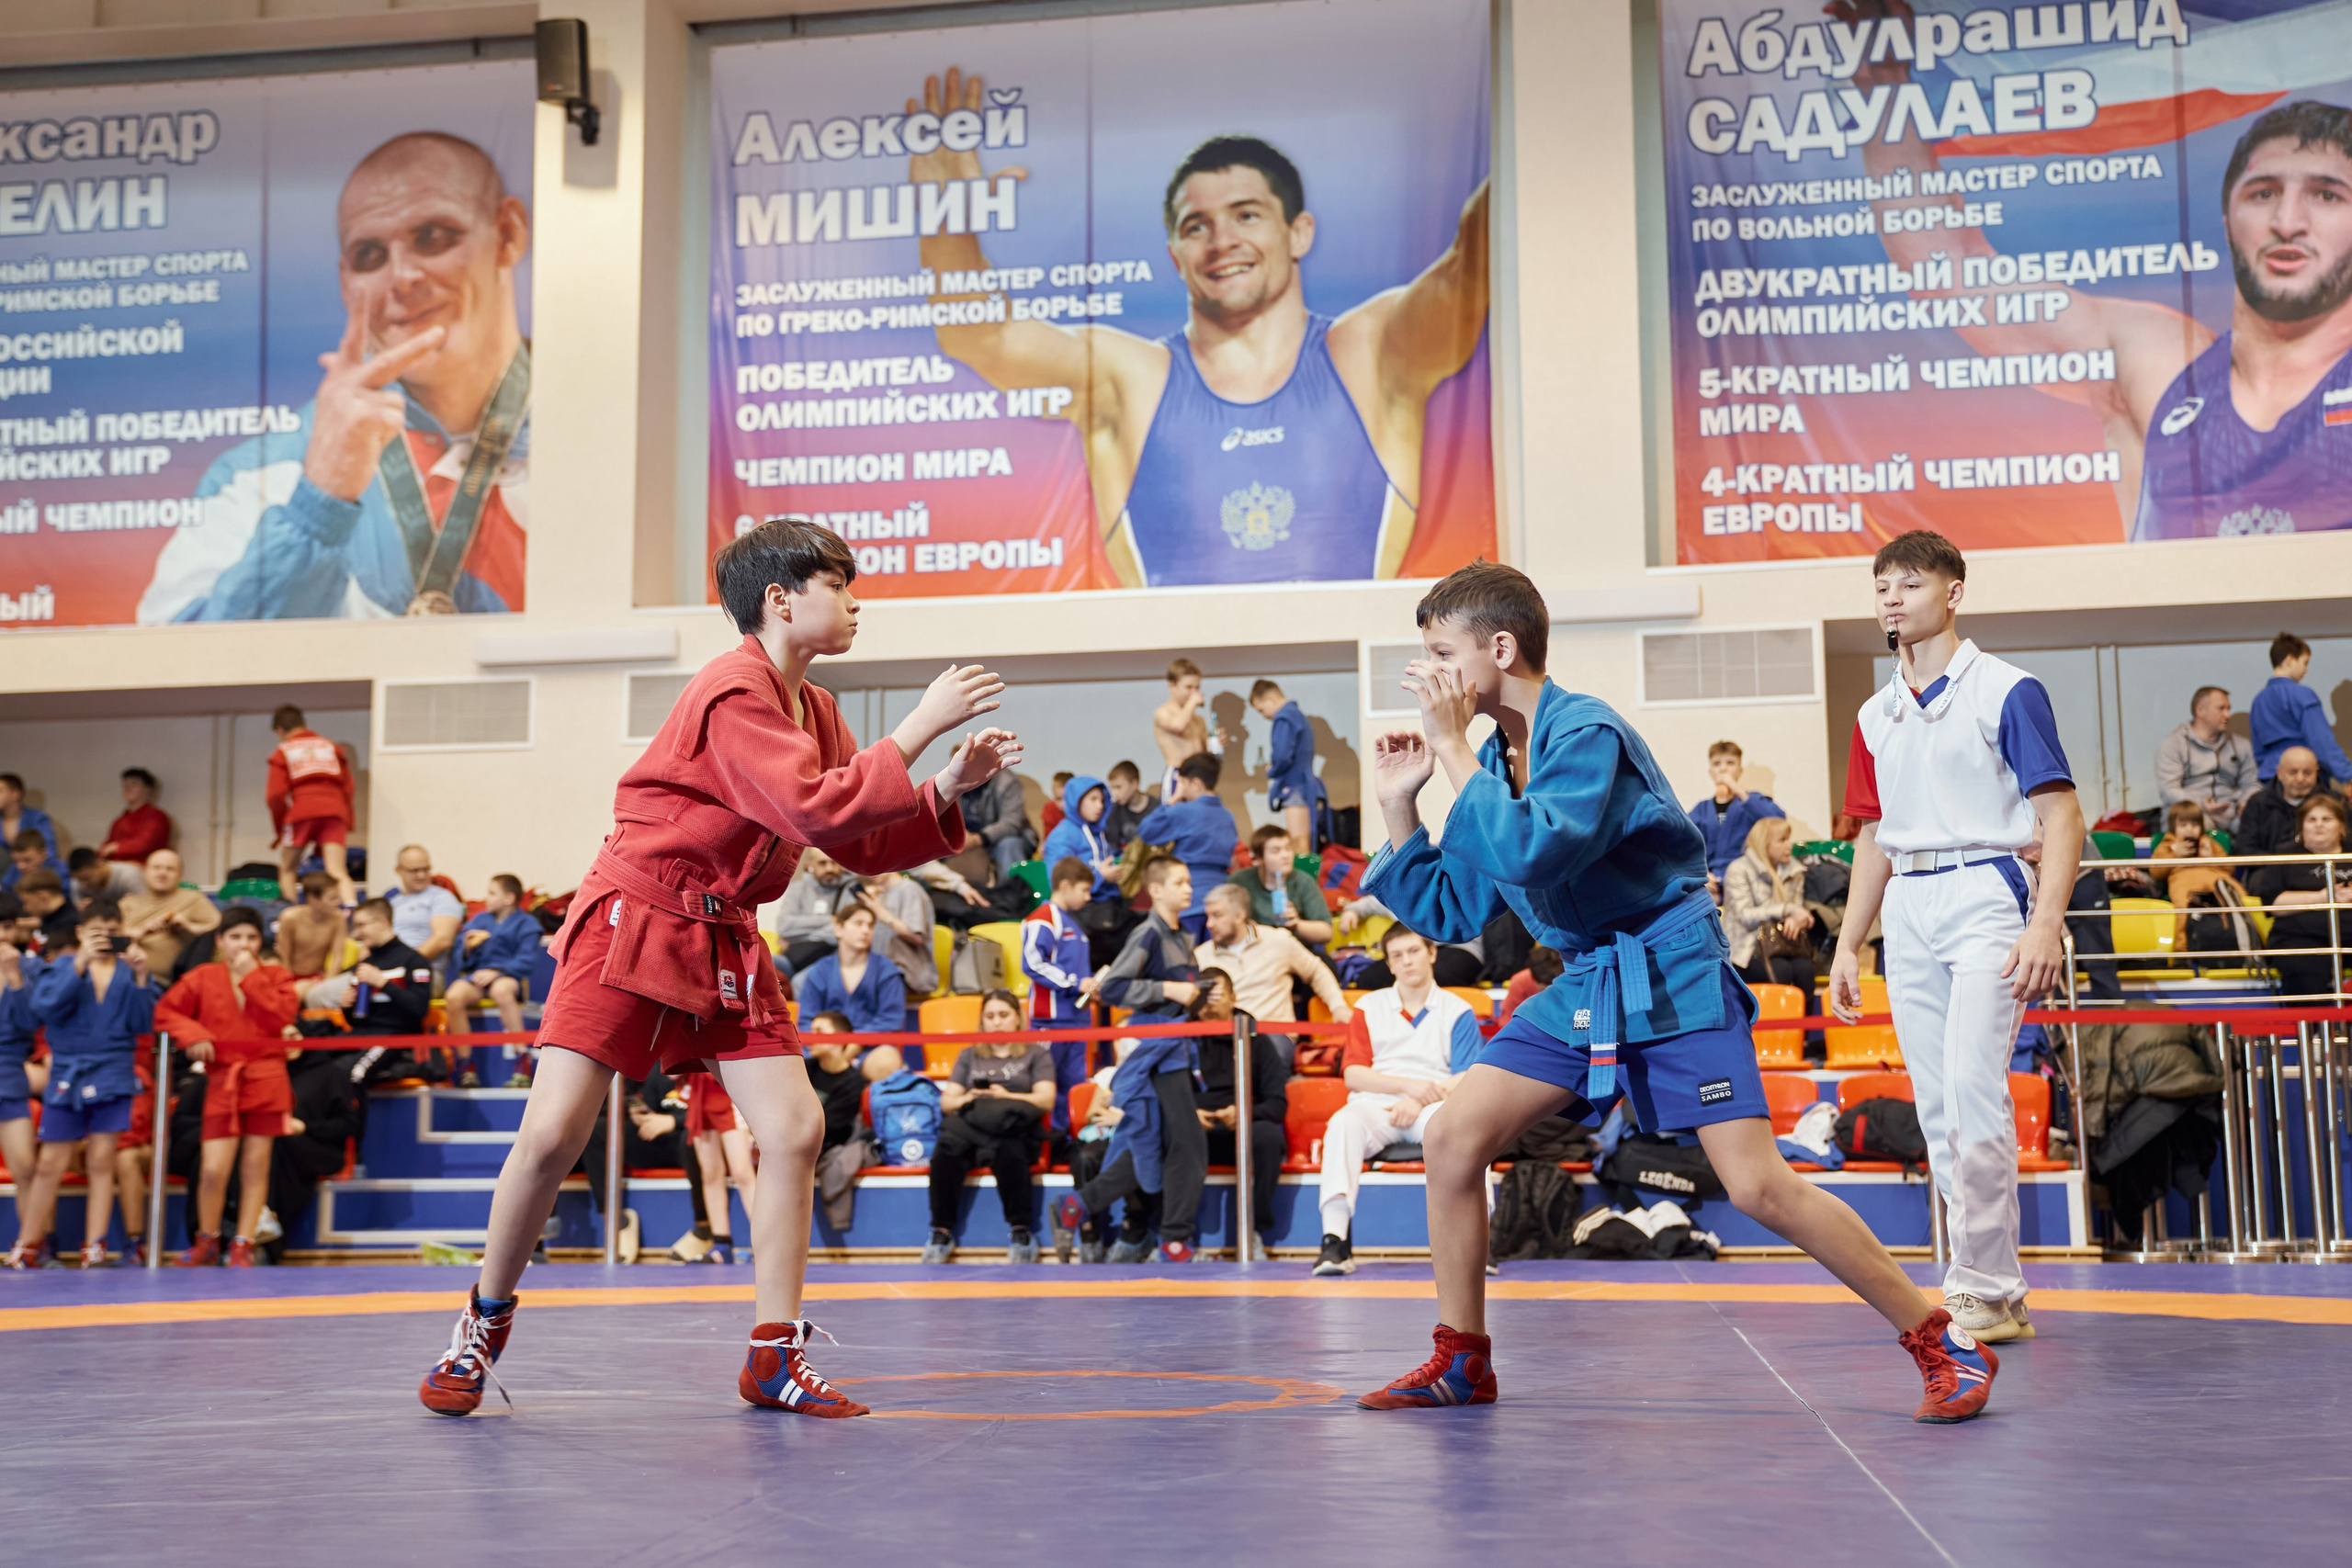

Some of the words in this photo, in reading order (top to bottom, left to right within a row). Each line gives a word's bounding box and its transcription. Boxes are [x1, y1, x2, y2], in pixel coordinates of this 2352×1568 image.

[1685, 0, 2189, 79] Абдулрашид
[732, 88, 1027, 166] Алексей
[1687, 69, 2098, 162] САДУЛАЕВ
[1691, 166, 1913, 208] ЗАСЛУЖЕННЫЙ
[1920, 164, 2038, 197] МАСТЕР
[2044, 155, 2163, 185] СПОРТА
[0, 174, 166, 236] ЕЛИН
[735, 176, 1017, 248] МИШИН
[1691, 218, 1732, 242] ПО
[1737, 205, 1876, 241] ВОЛЬНОЙ
[1883, 202, 2004, 234] БОРЬБЕ
[53, 254, 151, 281] МАСТЕР
[153, 249, 249, 276] СПОРТА
[736, 267, 935, 307] ЗАСЛУЖЕННЫЙ
[941, 267, 1045, 296] МАСТЕР
[1049, 261, 1153, 287] СПОРТА
[1694, 251, 1953, 306] ДВУКРАТНЫЙ
[1962, 241, 2220, 286] ПОБЕДИТЕЛЬ
[0, 280, 114, 313] ИМСКОЙ
[117, 278, 221, 308] БОРЬБЕ
[737, 313, 774, 337] ПО
[779, 291, 1006, 334] ГРЕКО-РИМСКОЙ
[1012, 292, 1124, 321] БОРЬБЕ
[1696, 295, 1987, 337] ОЛИМПИЙСКИХ
[1996, 291, 2070, 324] ИГР
[736, 355, 955, 394] ПОБЕДИТЕЛЬ
[1698, 353, 1910, 399] 5-КРАТНЫЙ
[1919, 349, 2116, 389] ЧЕМПИОН
[95, 404, 302, 443] ПОБЕДИТЕЛЬ
[735, 389, 1000, 432] ОЛИМПИЙСКИХ
[1006, 387, 1073, 418] ИГР
[1699, 403, 1806, 437] МИРА
[108, 446, 172, 476] ИГР
[734, 453, 905, 487] ЧЕМПИОН
[912, 447, 1012, 480] МИРА
[1701, 453, 1915, 497] 4-КРАТНЫЙ
[1923, 451, 2120, 490] ЧЕМПИОН
[44, 497, 204, 532] ЧЕМПИОН
[1702, 502, 1862, 536] ЕВРОПЫ
[914, 537, 1063, 573] ЕВРОПЫ
[1699, 1081, 1730, 1093] DECATHLON
[1701, 1090, 1732, 1102] SAMBO
